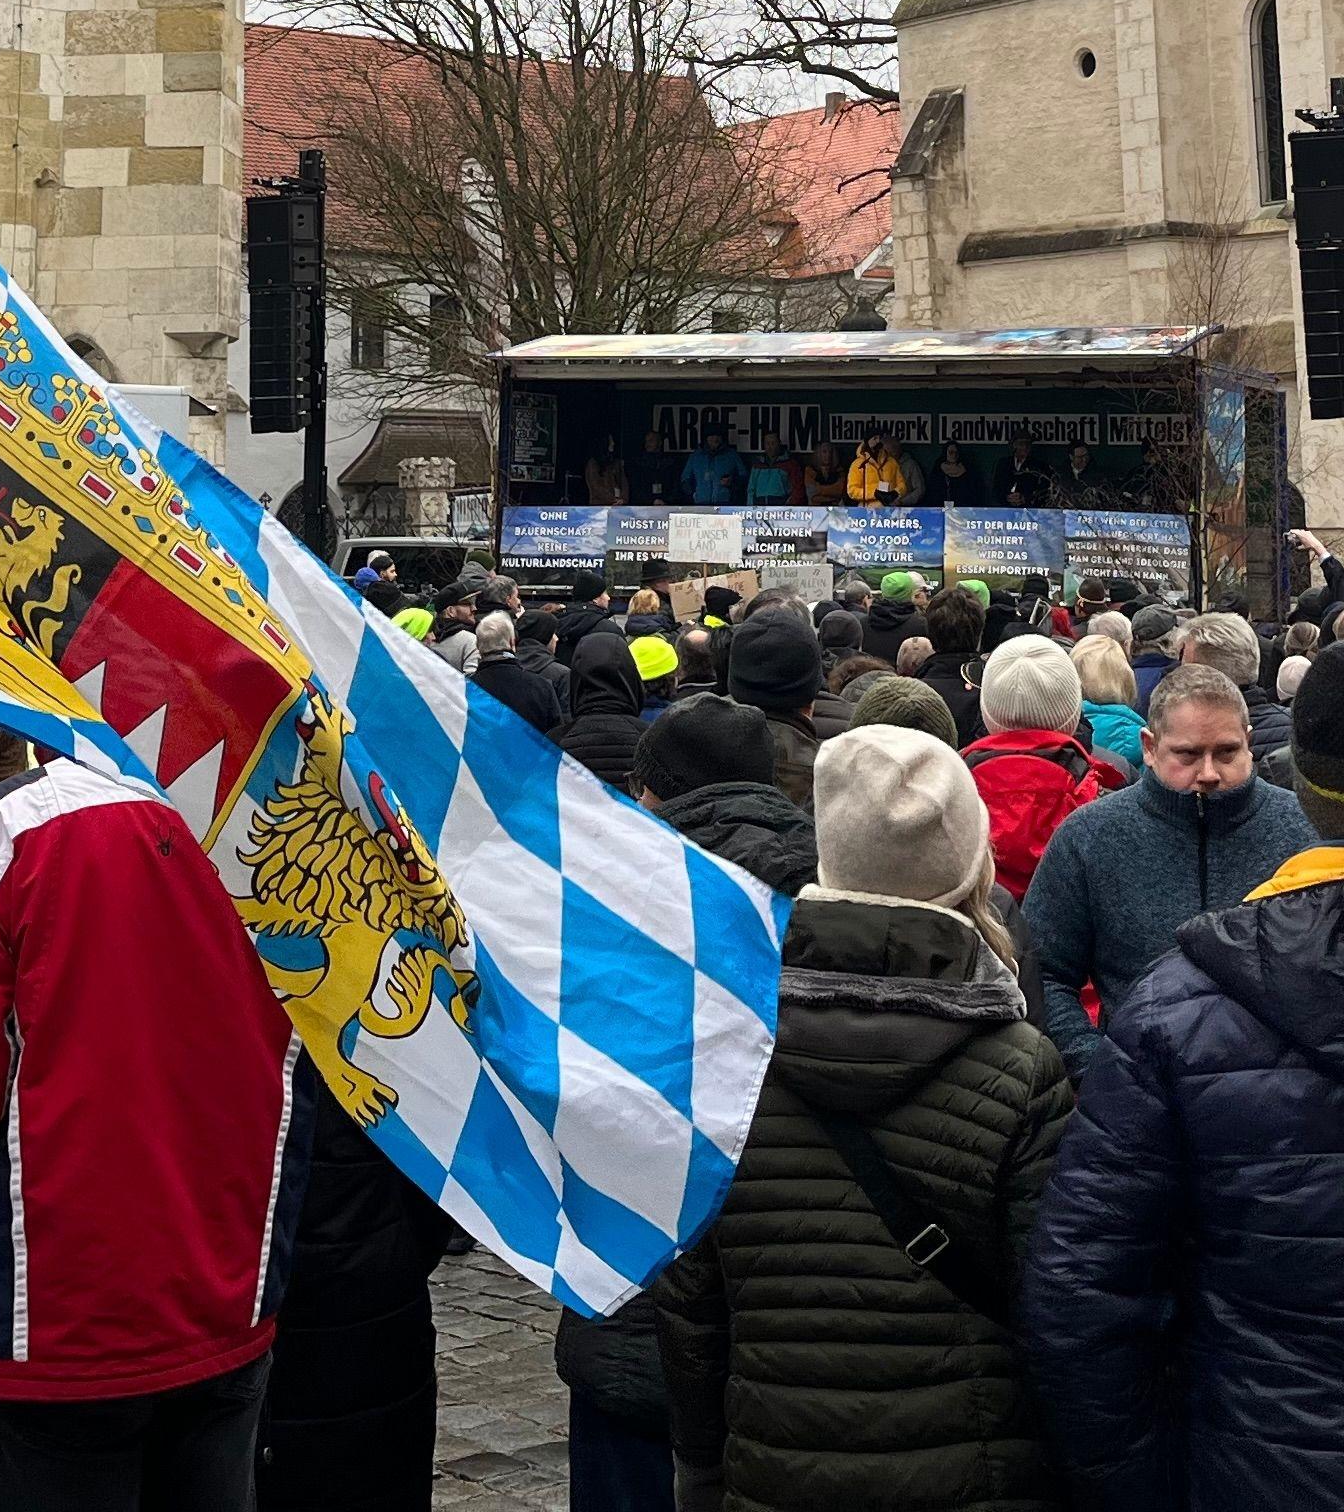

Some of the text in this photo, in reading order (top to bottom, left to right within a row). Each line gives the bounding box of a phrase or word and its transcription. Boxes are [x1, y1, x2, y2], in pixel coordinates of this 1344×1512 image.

[831, 416, 928, 440] Handwerk
[941, 415, 1096, 442] Landwirtschaft
[540, 511, 568, 521] OHNE
[674, 515, 703, 528] LEUTE
[756, 511, 797, 520] DENKEN
[800, 511, 813, 521] IN
[620, 517, 669, 530] MÜSST IH
[851, 518, 867, 530] NO
[966, 520, 1038, 531] IST DER BAUER
[1101, 516, 1128, 526] WENN
[1129, 518, 1147, 528] DER
[514, 527, 592, 536] BAUERNSCHAFT
[697, 529, 728, 542] UNSER
[740, 527, 812, 537] ENERATIONEN
[615, 535, 668, 546] HUNGERN,
[689, 539, 717, 552] LAND
[860, 535, 877, 545] NO
[976, 535, 1024, 546] RUINIERT
[537, 542, 568, 552] KEINE
[746, 542, 796, 553] NICHT IN
[1163, 546, 1189, 556] DASS
[614, 551, 634, 561] IHR
[636, 551, 649, 562] ES
[855, 551, 914, 562] NO FUTURE
[978, 550, 1028, 561] WIRD DAS
[1068, 554, 1089, 564] MAN
[1090, 555, 1113, 565] GELD
[501, 557, 604, 568] KULTURLANDSCHAFT
[956, 564, 1050, 577] ESSEN IMPORTIERT
[1082, 568, 1111, 578] NICHT
